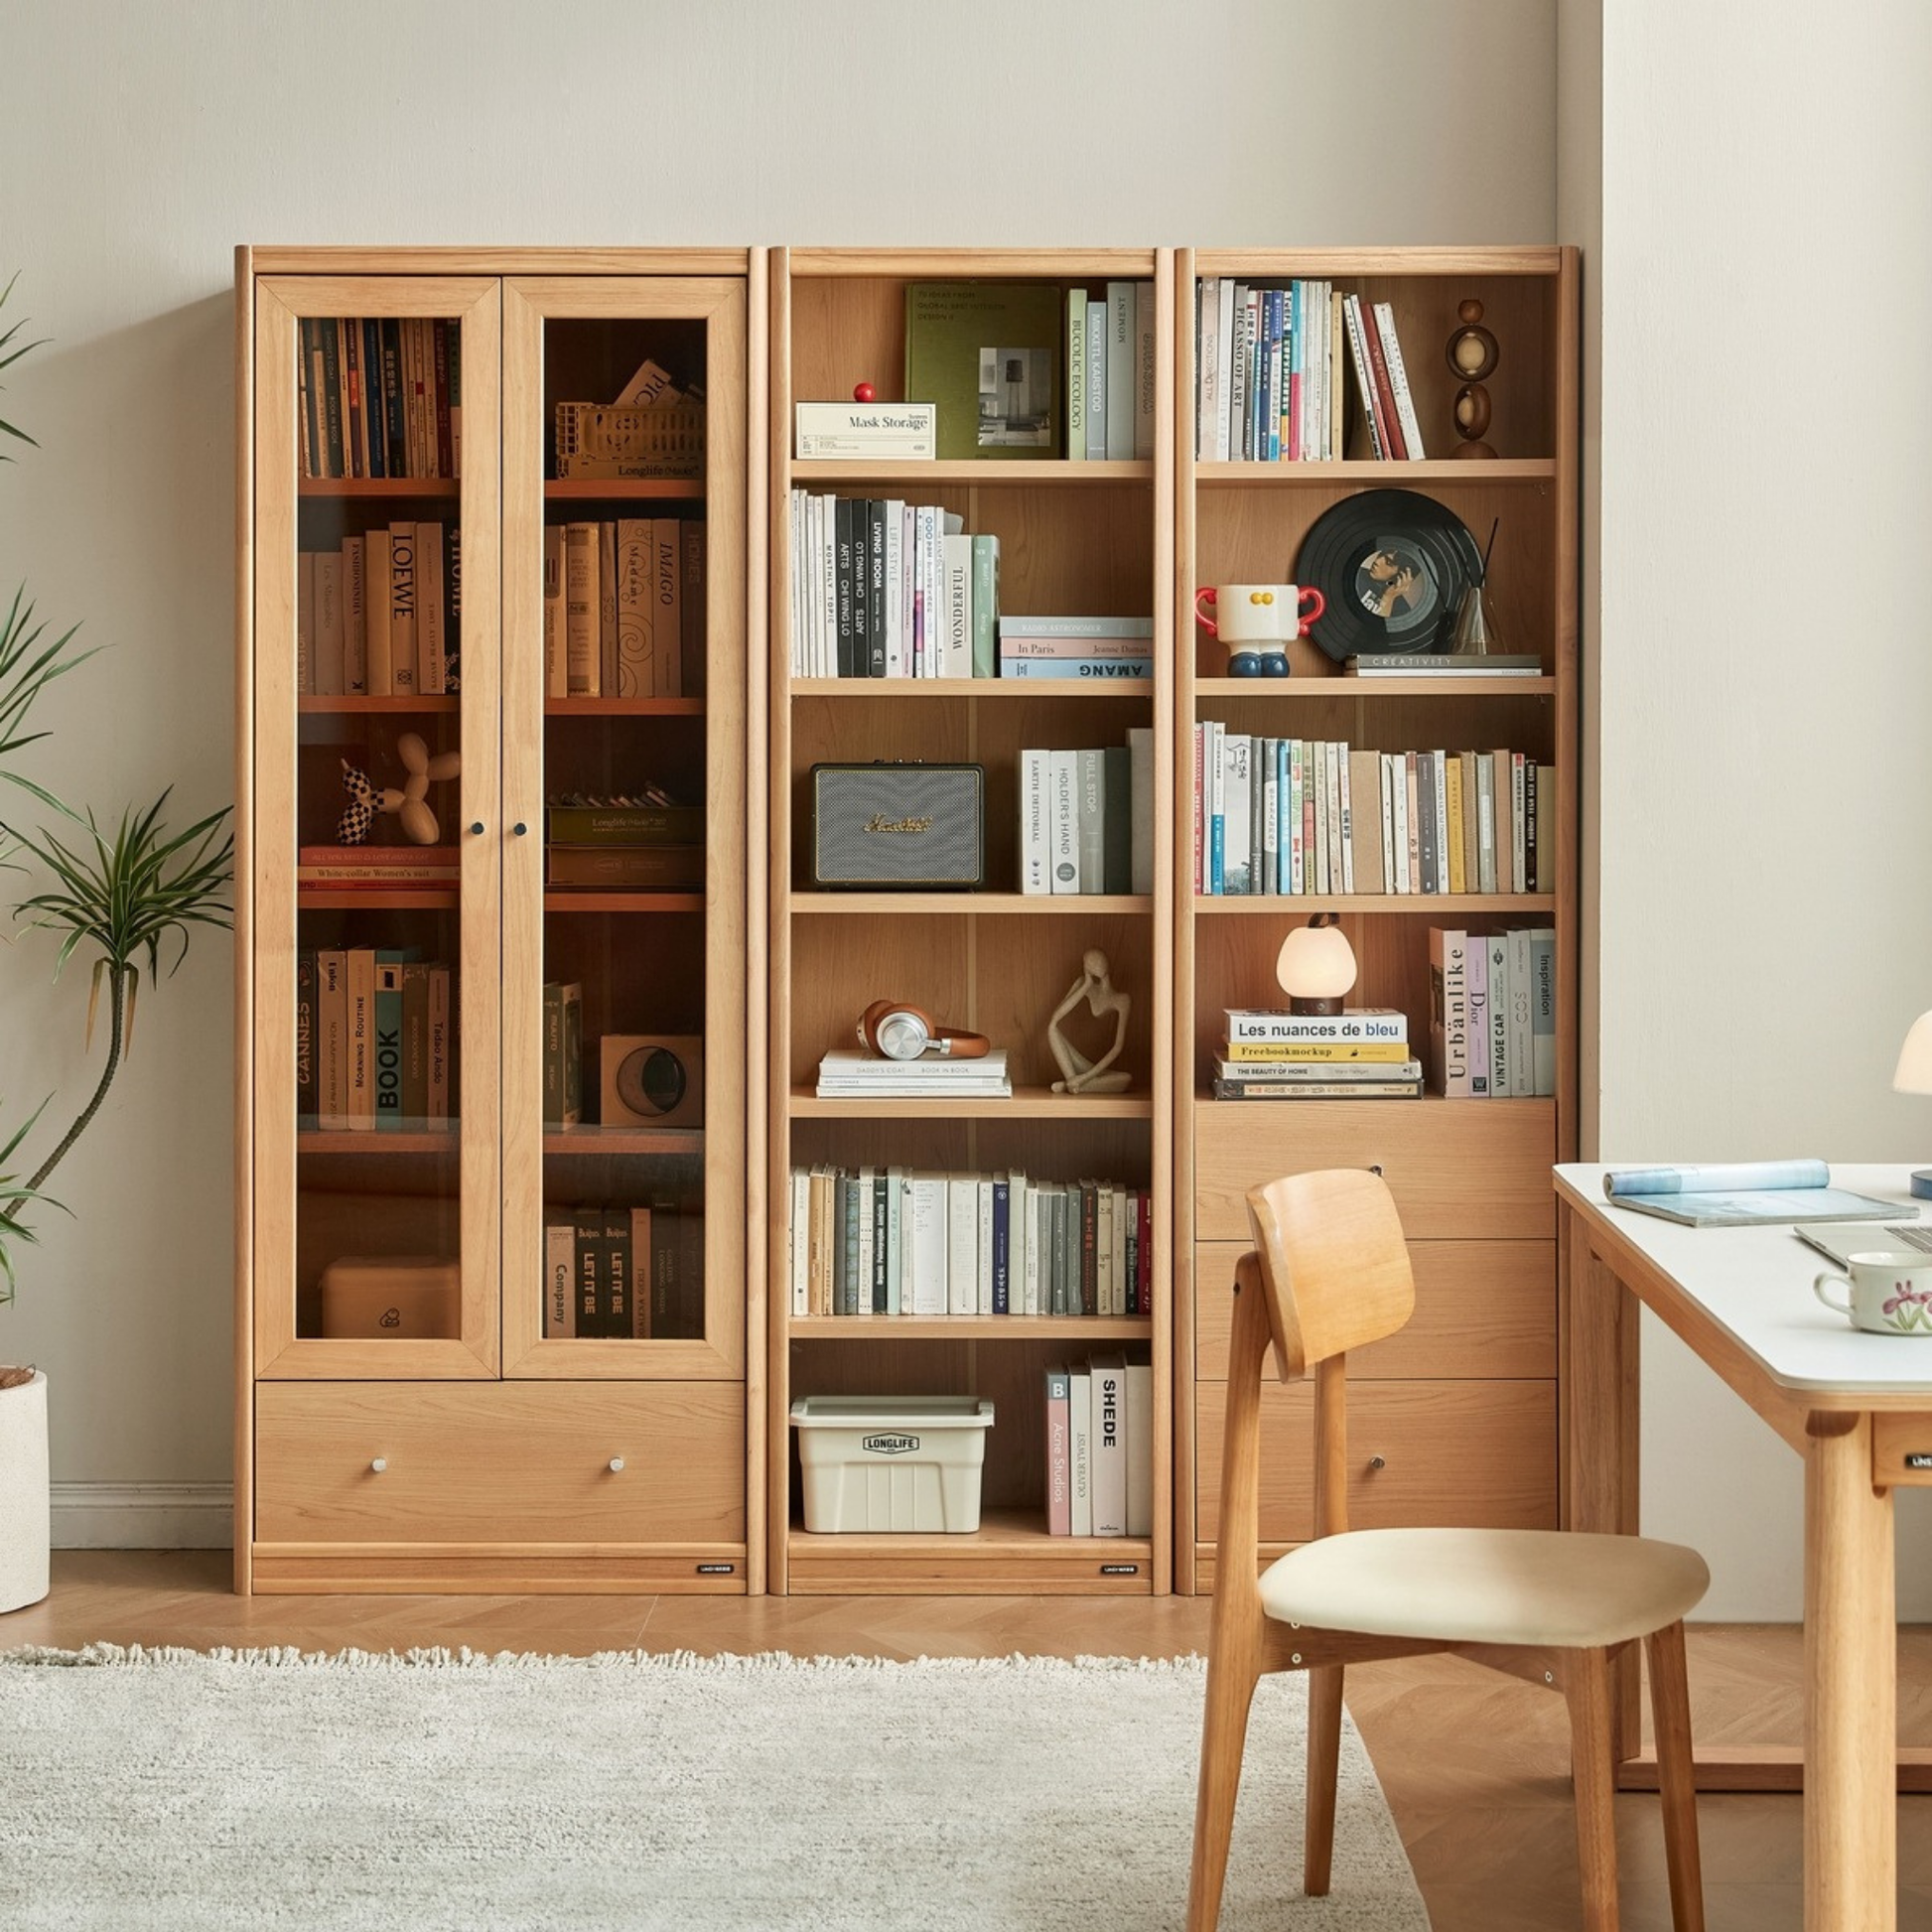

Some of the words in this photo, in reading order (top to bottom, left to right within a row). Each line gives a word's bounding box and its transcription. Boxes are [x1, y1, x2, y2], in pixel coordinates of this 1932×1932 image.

[1118, 297, 1127, 344] MOMENT
[1234, 308, 1245, 360] PICASSO
[1072, 320, 1081, 372] BUCOLIC
[1234, 364, 1244, 380] OF
[1072, 374, 1081, 430] ECOLOGY
[1233, 385, 1243, 409] ART
[849, 415, 880, 428] Mask
[883, 415, 928, 431] Storage
[873, 521, 883, 554] LIVING
[825, 544, 834, 589] MONTHLY
[840, 542, 850, 569] ARTS
[392, 534, 415, 621] LOEWE
[659, 542, 674, 607] IMAGO
[873, 557, 883, 589] ROOM
[603, 596, 616, 623] COS
[855, 608, 865, 635] ARTS
[952, 566, 964, 651] WONDERFUL
[1019, 643, 1030, 654] In
[1031, 643, 1056, 654] Paris
[1372, 657, 1452, 666] CREATIVITY
[1079, 664, 1143, 676] AMANG
[1086, 753, 1096, 781] FULL
[1059, 766, 1070, 821] HOLDER'S
[1060, 822, 1070, 856] HAND
[317, 869, 371, 879] White-collar
[373, 869, 411, 878] Women's
[414, 869, 430, 878] suit
[1538, 954, 1551, 1017] Inspiration
[355, 996, 365, 1037] ROUTINE
[1447, 948, 1466, 1080] Urbänlike
[1469, 990, 1487, 1027] Dior
[1514, 991, 1529, 1025] COS
[434, 1022, 444, 1054] Tadao
[1239, 1023, 1266, 1037] Les
[1271, 1026, 1337, 1037] nuances
[1341, 1023, 1361, 1037] de
[1365, 1023, 1399, 1037] bleu
[1494, 1013, 1505, 1035] CAR
[299, 1001, 311, 1084] CANNES
[1241, 1046, 1333, 1057] Freebookmockup
[355, 1043, 365, 1088] MORNING
[377, 1029, 399, 1109] BOOK
[434, 1055, 444, 1084] Ando
[887, 1066, 905, 1075] COAT
[921, 1066, 940, 1075] BOOK
[950, 1066, 970, 1075] BOOK
[1494, 1039, 1506, 1088] VINTAGE
[583, 1252, 596, 1276] LET
[611, 1252, 622, 1275] LET
[553, 1263, 568, 1325] Company
[584, 1280, 596, 1294] IT
[611, 1279, 622, 1294] IT
[584, 1295, 596, 1315] BE
[611, 1295, 622, 1315] BE
[1052, 1383, 1065, 1398] B
[1103, 1379, 1117, 1449] SHEDE
[868, 1438, 915, 1449] LONGLIFE
[1053, 1423, 1066, 1454] Acne
[1076, 1432, 1087, 1461] TWIST
[1053, 1457, 1067, 1504] Studios
[1076, 1464, 1087, 1499] OLIVER
